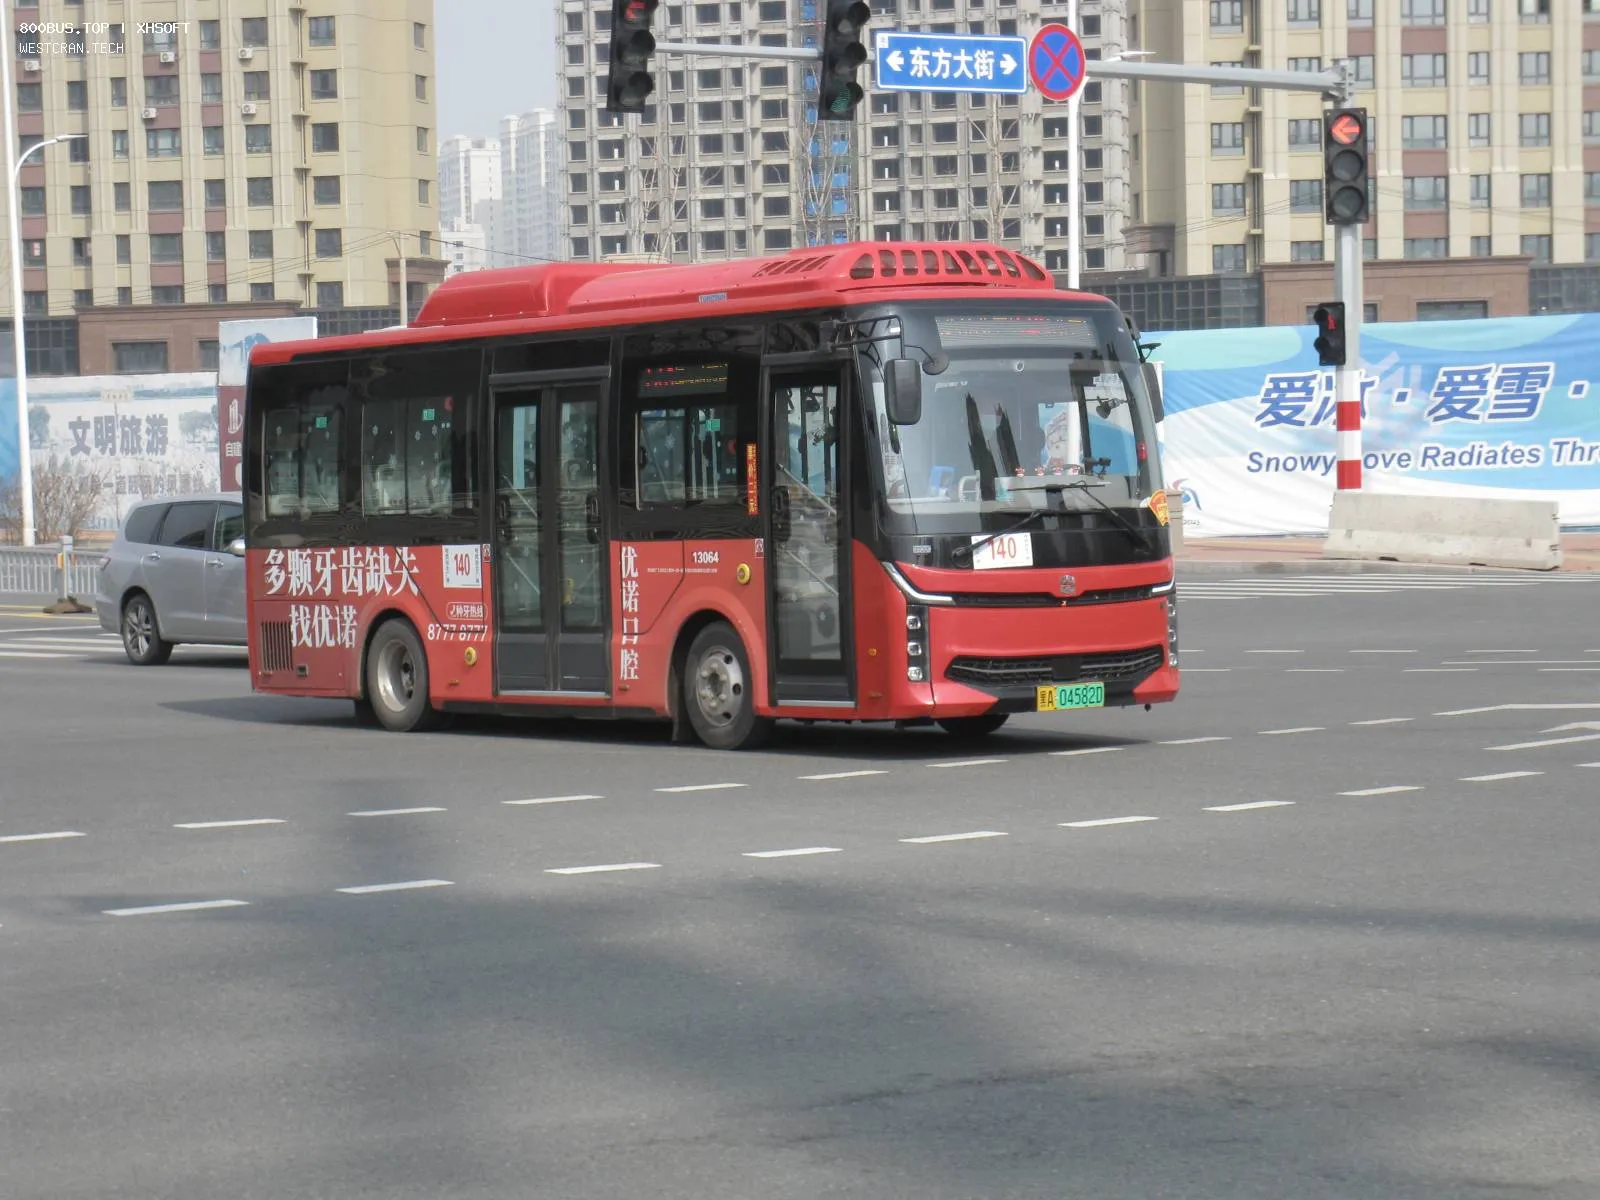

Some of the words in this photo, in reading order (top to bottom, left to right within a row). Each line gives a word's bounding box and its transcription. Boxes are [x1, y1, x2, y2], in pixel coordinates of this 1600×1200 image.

[909, 46, 995, 80] 东方大街
[68, 414, 169, 457] 文明旅游
[1247, 451, 1337, 476] Snowy
[1363, 451, 1412, 470] ove
[1420, 444, 1541, 468] Radiates
[454, 553, 470, 576] 140
[692, 551, 720, 564] 13064
[987, 535, 1017, 560] 140
[264, 547, 419, 596] 多颗牙齿缺失
[289, 604, 358, 649] 找优诺
[620, 545, 640, 681] 优诺口腔
